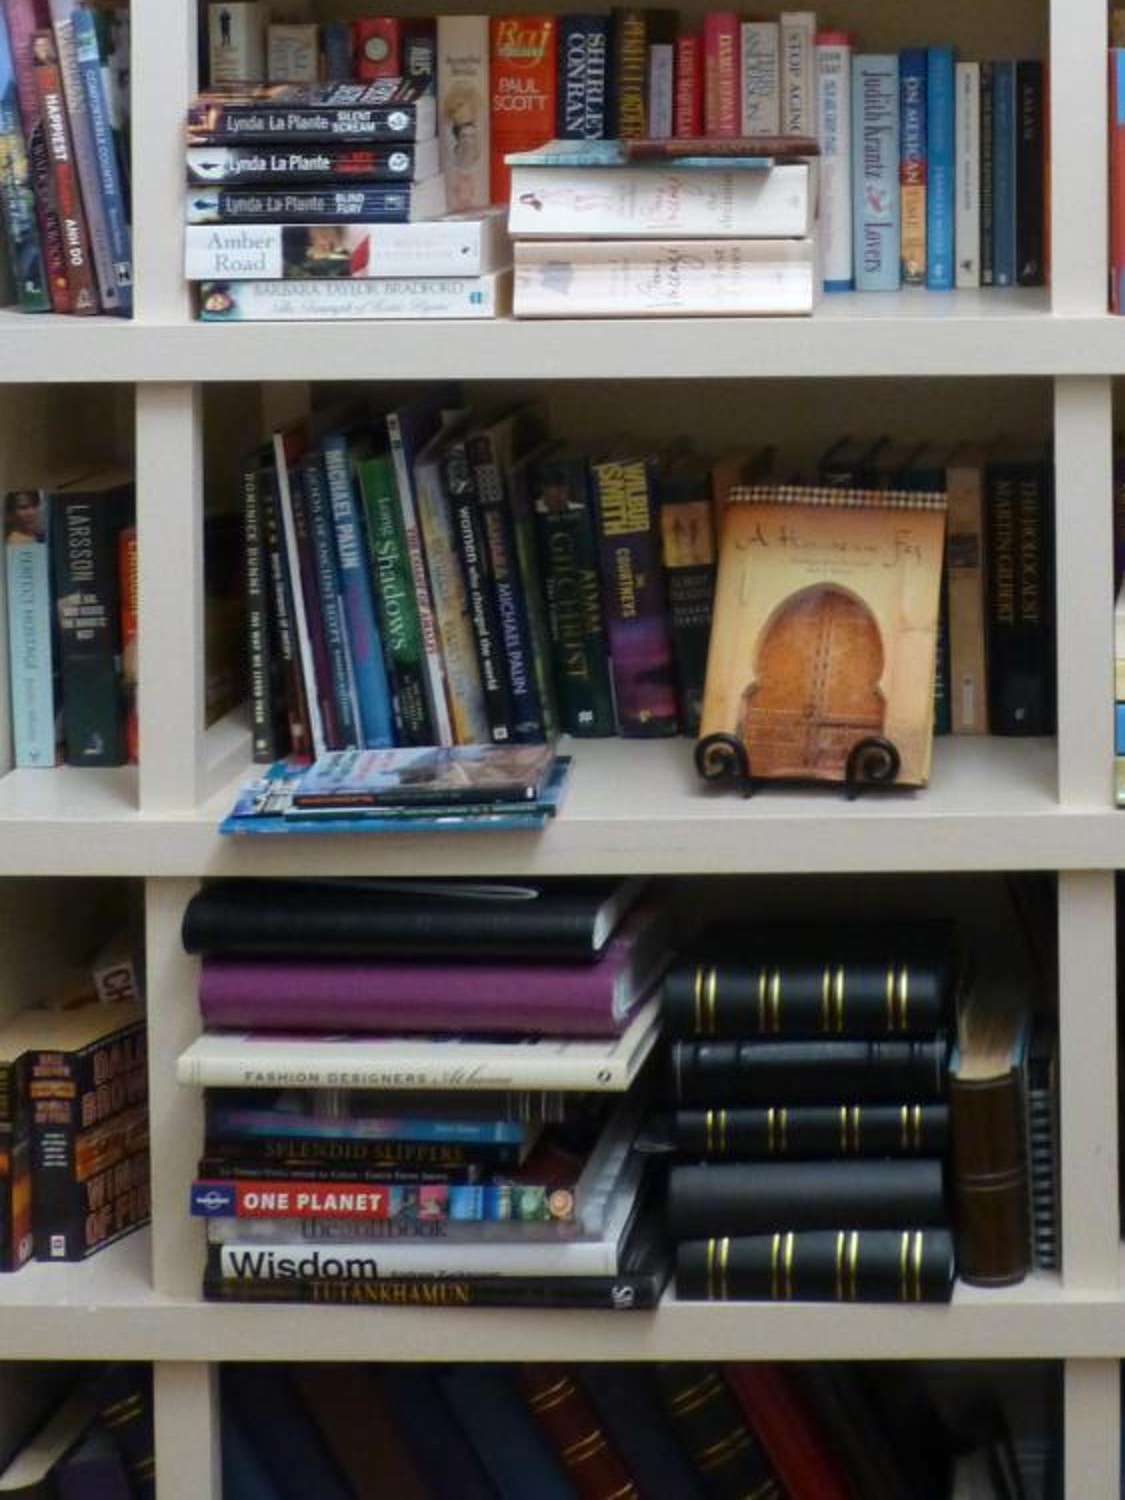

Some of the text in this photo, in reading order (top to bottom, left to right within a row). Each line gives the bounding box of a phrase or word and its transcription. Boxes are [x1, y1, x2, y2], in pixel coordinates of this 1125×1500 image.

[566, 33, 585, 132] CONRAN
[586, 33, 605, 141] SHIRLEY
[493, 95, 548, 112] SCOTT
[45, 93, 67, 161] HAPPIEST
[226, 112, 329, 133] Lynda La Plante
[228, 151, 331, 173] Lynda La Plante
[861, 70, 893, 274] Judith Krantz Lovers
[208, 231, 276, 251] Amber
[213, 253, 268, 273] Road
[325, 450, 359, 570] MICHAEL PALIN
[66, 505, 95, 582] LARSSON
[458, 506, 481, 564] women
[374, 539, 409, 651] Shadows
[243, 1071, 427, 1085] FASHION DESIGNERS
[243, 1191, 383, 1212] ONE PLANET
[230, 1251, 379, 1279] Wisdom
[309, 1280, 471, 1303] TUTANKHAMUN
